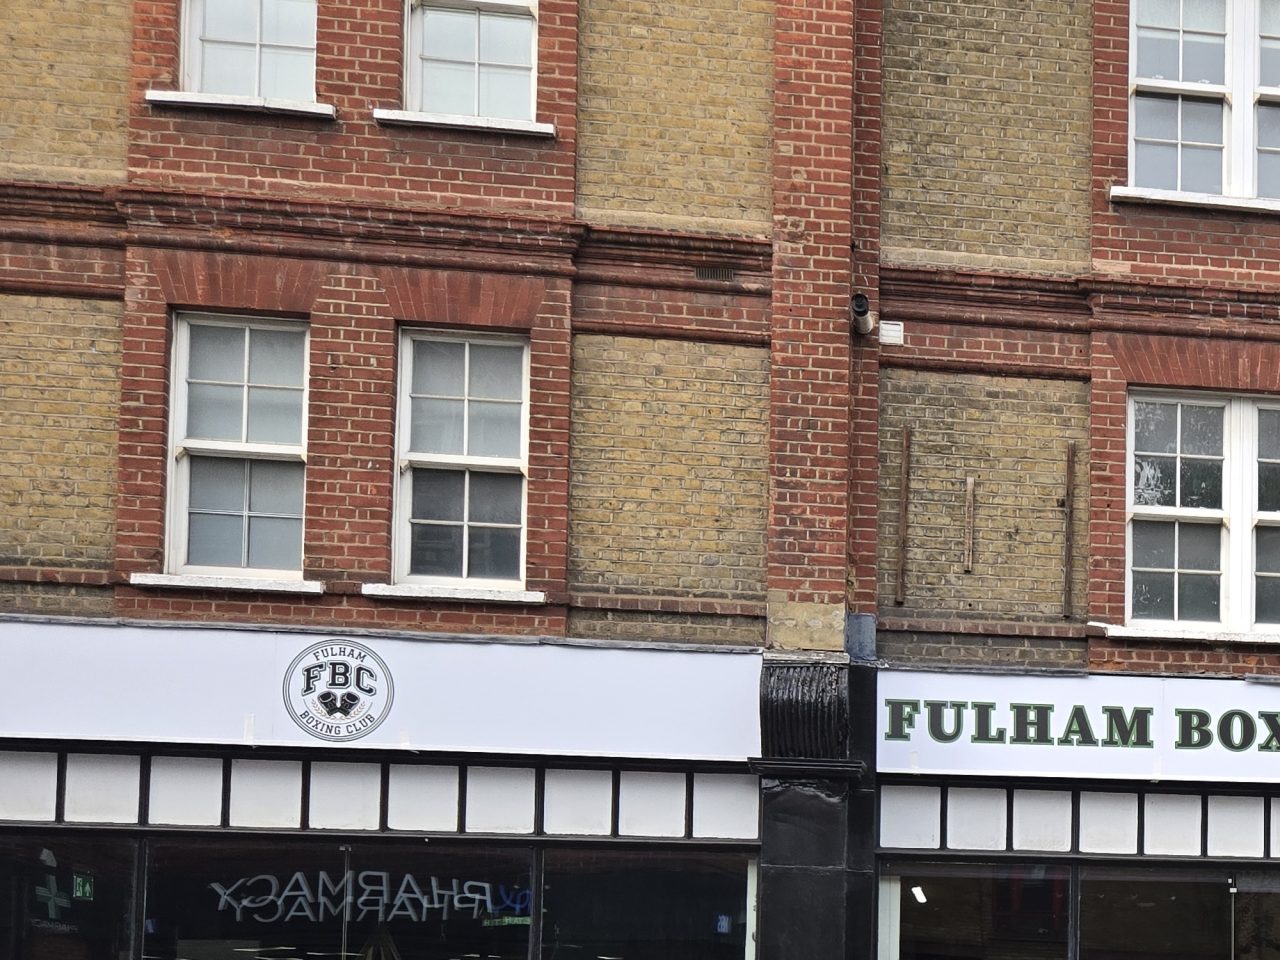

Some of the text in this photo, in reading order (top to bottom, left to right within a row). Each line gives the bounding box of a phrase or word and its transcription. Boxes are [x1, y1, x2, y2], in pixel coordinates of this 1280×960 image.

[312, 646, 367, 663] FULHAM
[301, 660, 377, 697] FBC
[299, 710, 376, 735] BOXING CLUB
[884, 699, 1154, 749] FULHAM
